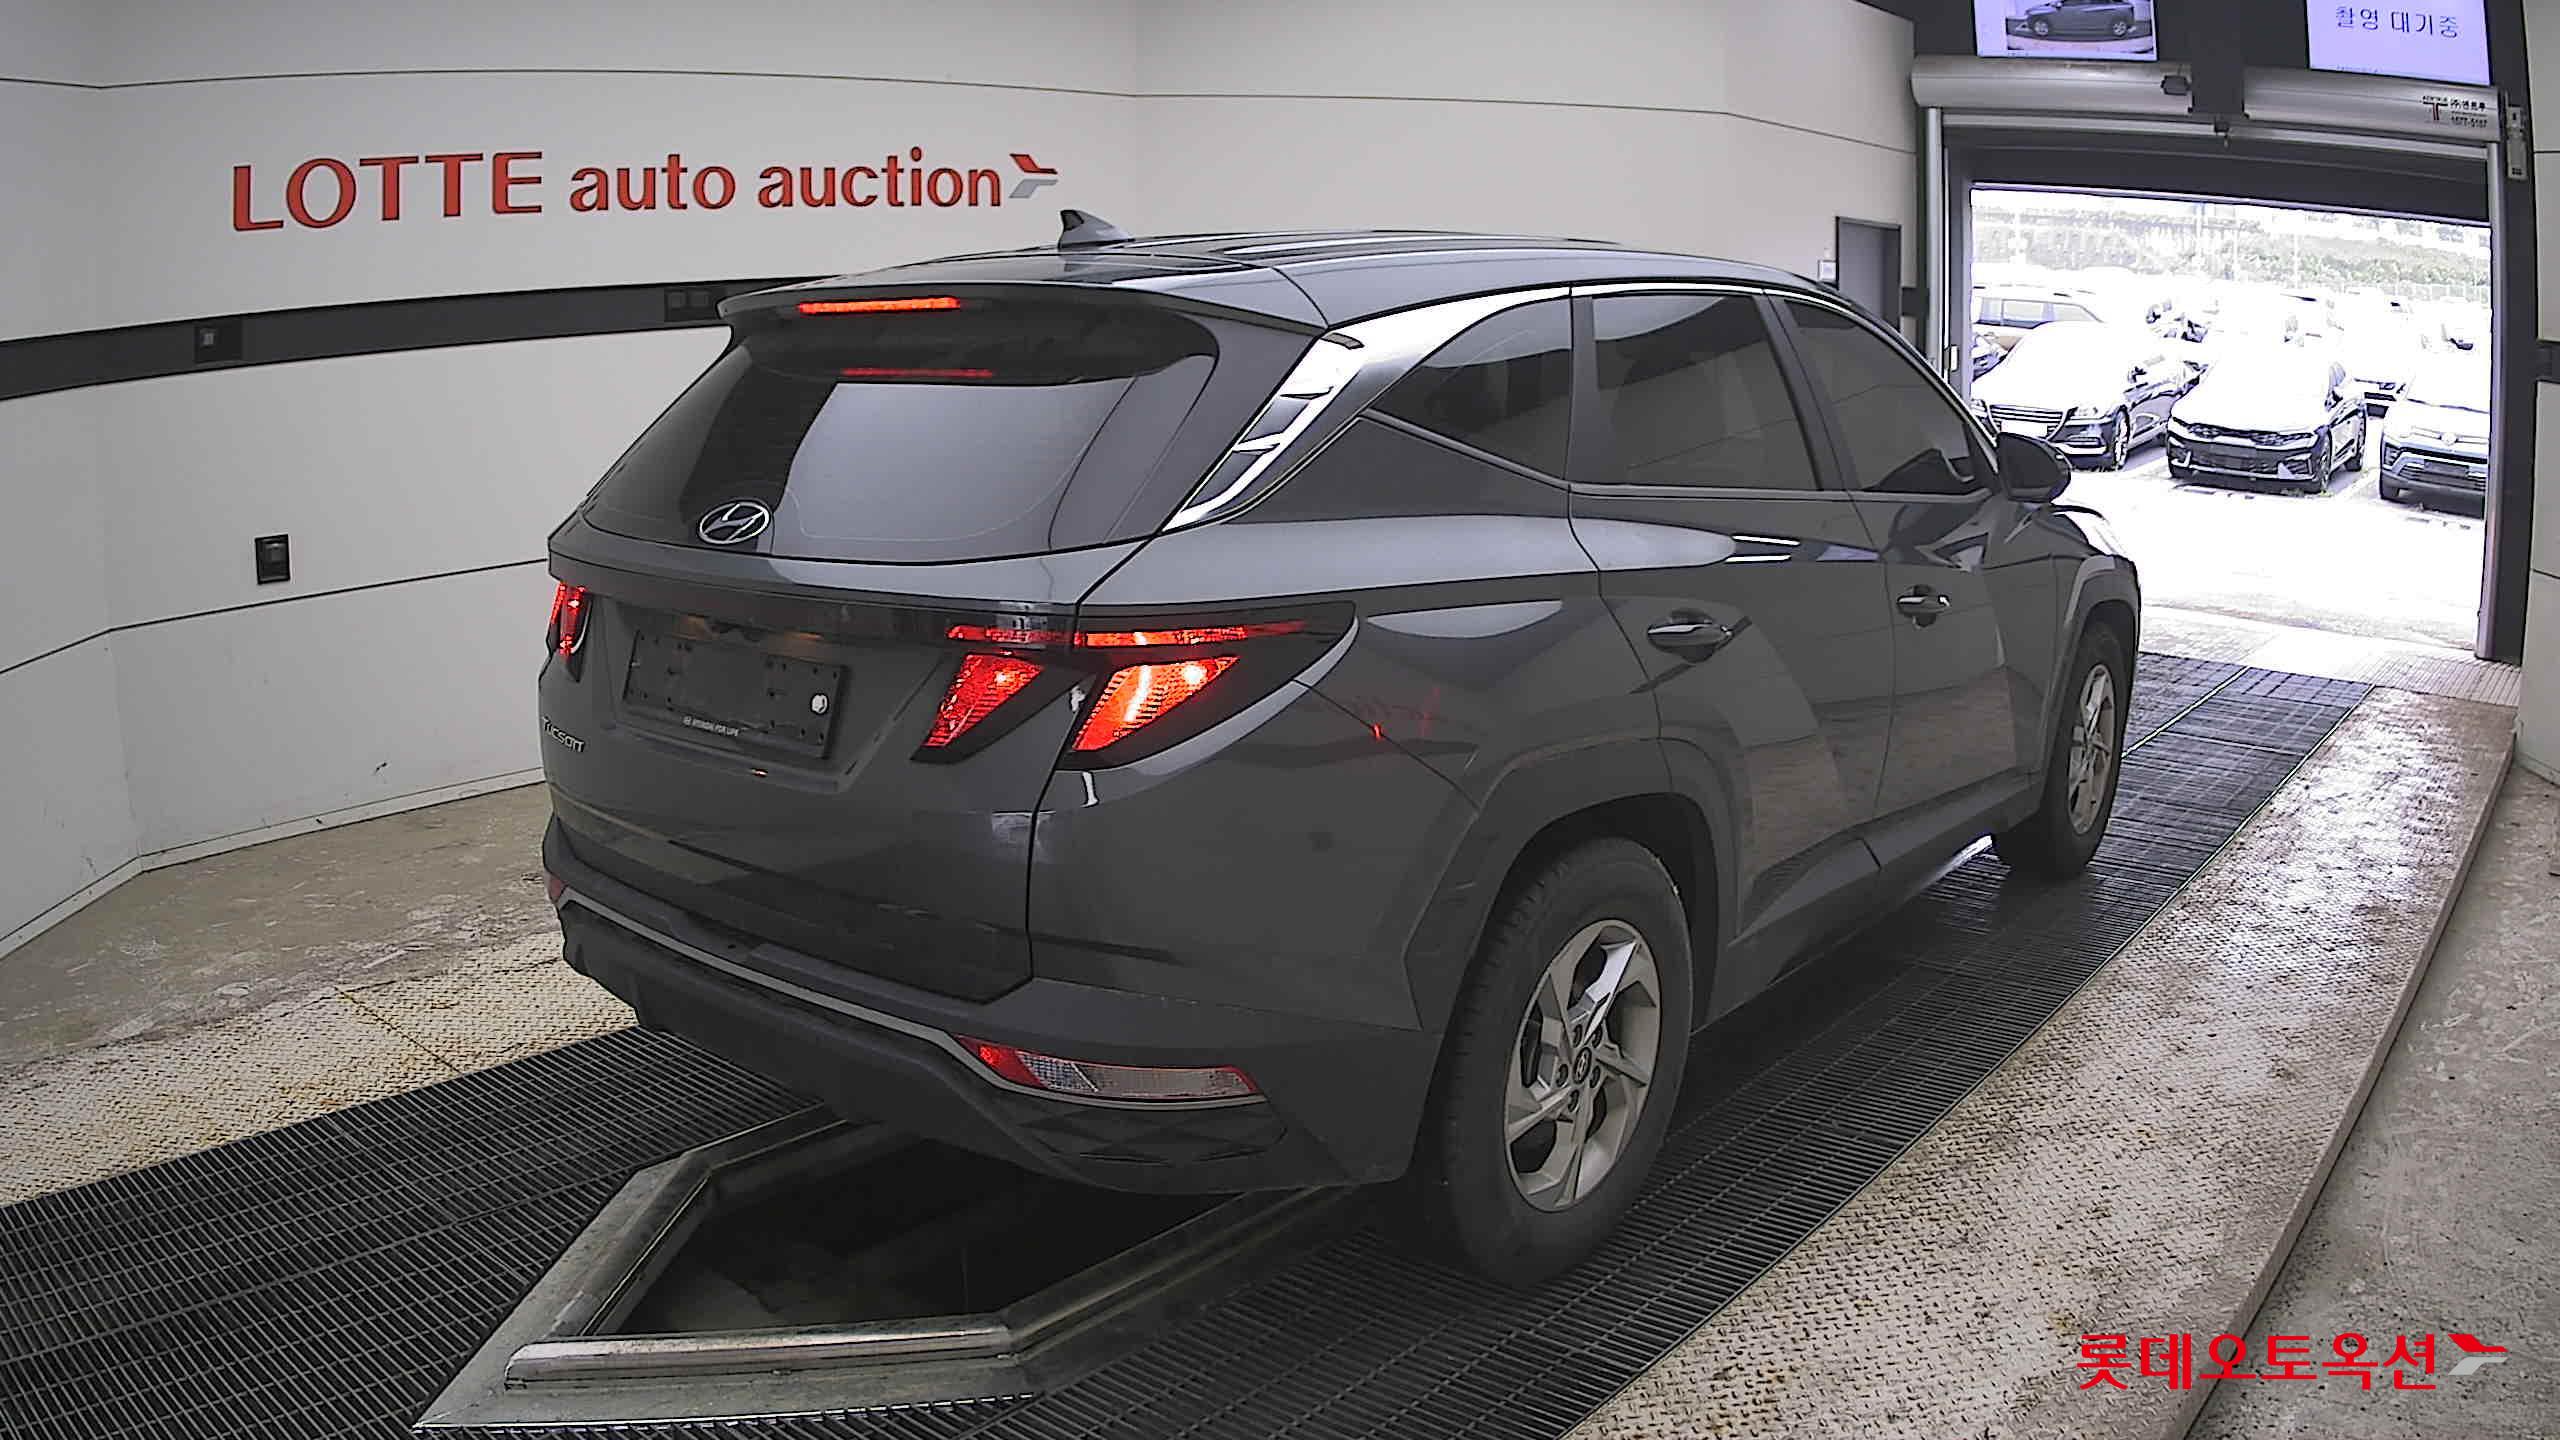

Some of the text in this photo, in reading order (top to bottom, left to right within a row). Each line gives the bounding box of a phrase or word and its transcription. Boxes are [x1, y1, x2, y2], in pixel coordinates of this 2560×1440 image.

[2391, 12, 2459, 38] 대기중
[233, 146, 1001, 232] LOTTE auto auction
